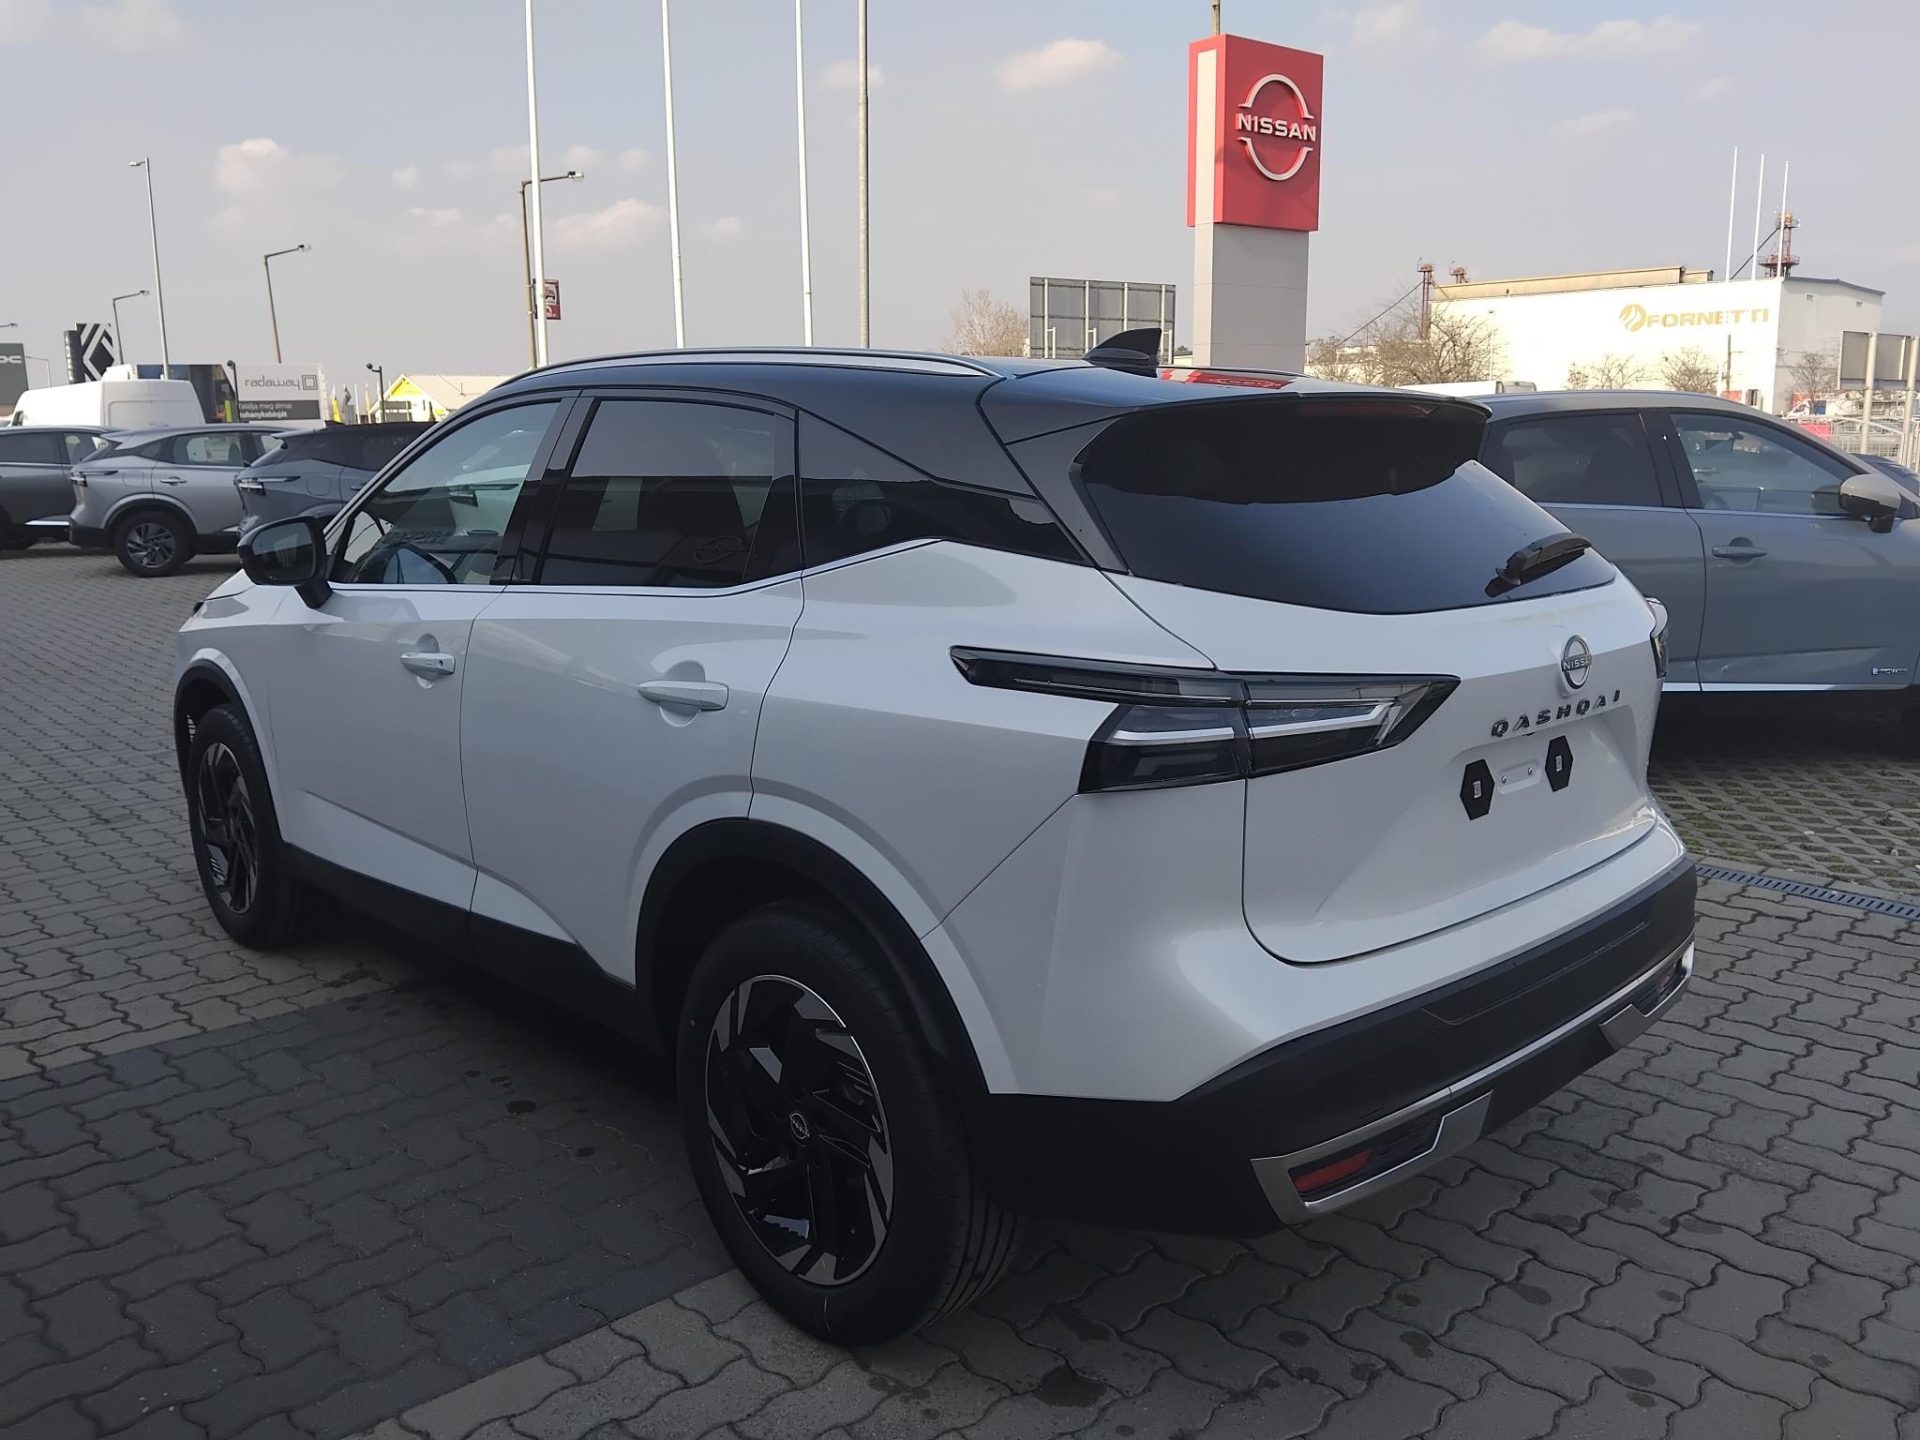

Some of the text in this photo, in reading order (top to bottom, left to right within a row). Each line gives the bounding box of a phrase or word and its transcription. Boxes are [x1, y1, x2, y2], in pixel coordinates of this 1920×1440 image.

[1235, 113, 1316, 141] NISSAN
[1648, 308, 1769, 328] FORNETTI
[244, 376, 301, 390] radaway
[1562, 654, 1592, 671] NISS
[1491, 690, 1620, 737] QASHQAI
